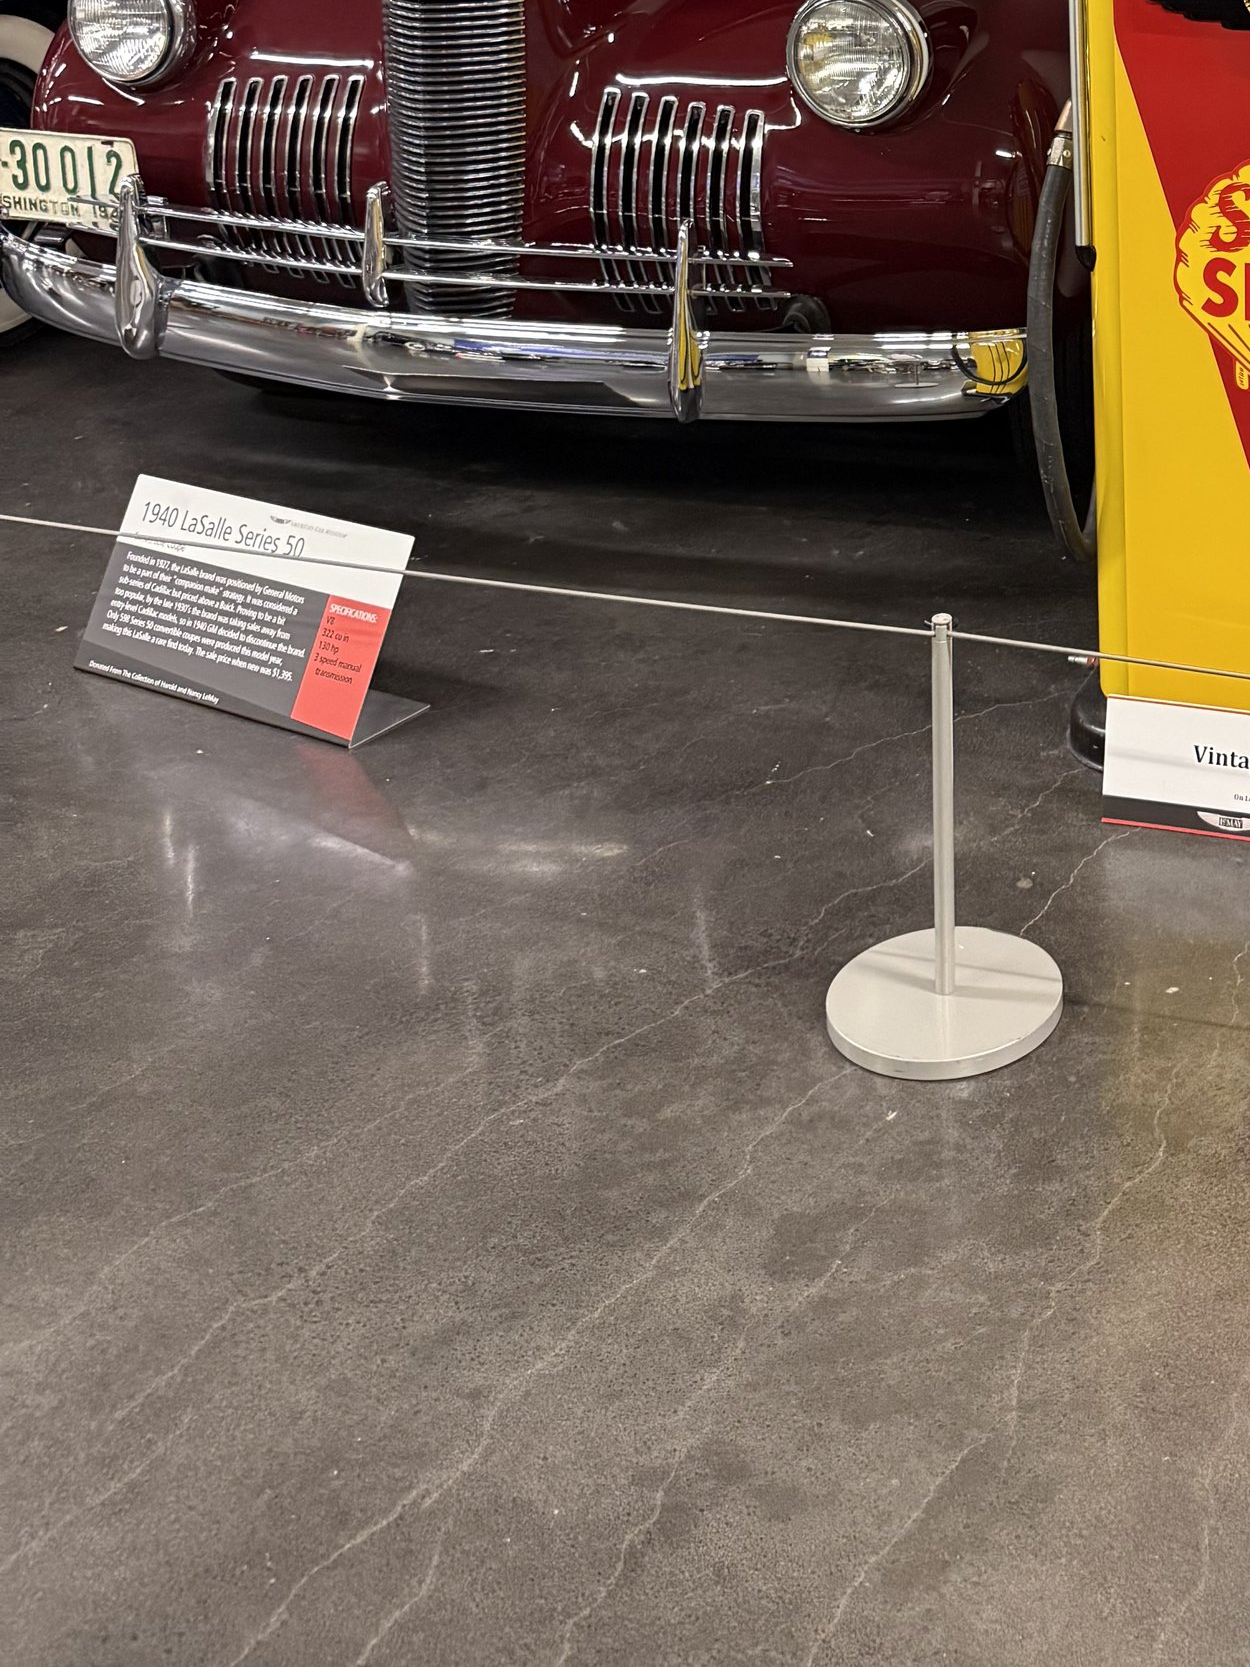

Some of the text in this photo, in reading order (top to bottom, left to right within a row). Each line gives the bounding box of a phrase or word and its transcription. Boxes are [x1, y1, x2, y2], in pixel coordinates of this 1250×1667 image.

[0, 195, 82, 218] SHINGTON
[142, 501, 179, 527] 1940
[180, 510, 232, 541] LaSalle
[234, 523, 280, 553] Series
[281, 535, 305, 559] 50
[126, 551, 150, 564] Founded
[149, 557, 156, 565] in
[170, 562, 180, 572] the
[179, 564, 199, 577] LaSalle
[198, 569, 216, 581] brand
[215, 575, 227, 584] was
[225, 578, 256, 591] positioned
[254, 583, 263, 595] by
[262, 585, 285, 598] General
[284, 591, 304, 604] Motors
[318, 640, 339, 655] 130 hp
